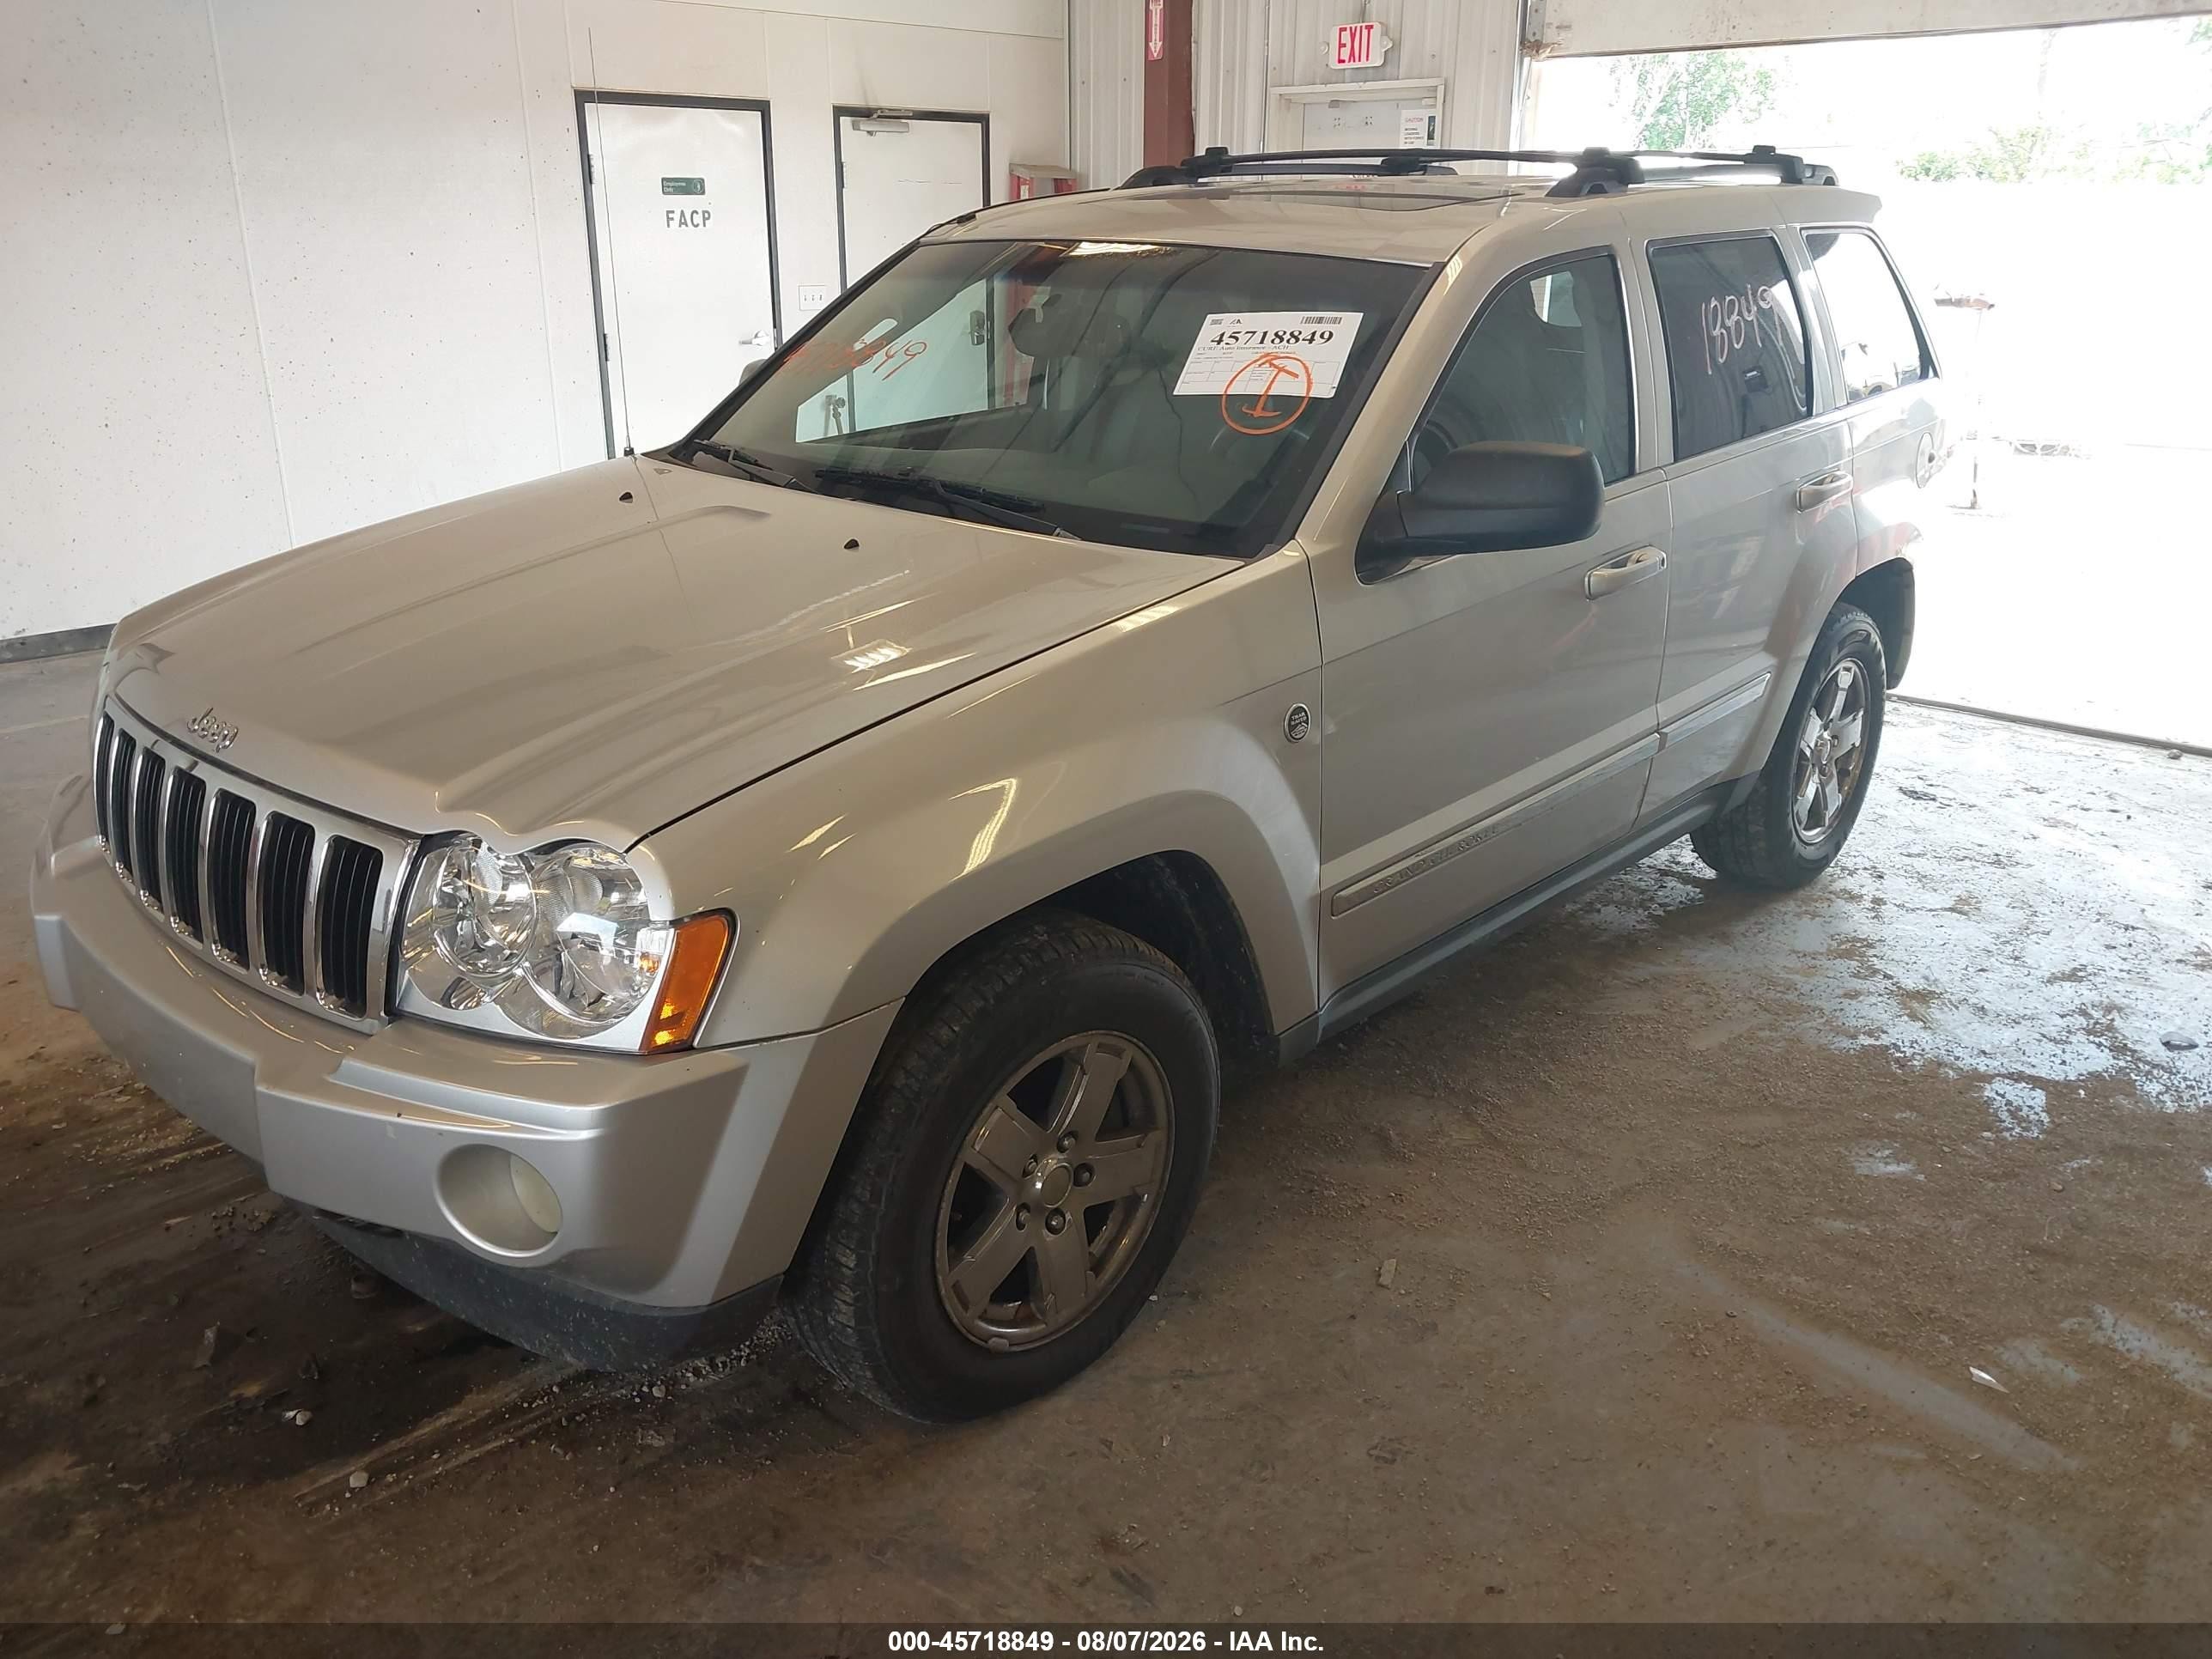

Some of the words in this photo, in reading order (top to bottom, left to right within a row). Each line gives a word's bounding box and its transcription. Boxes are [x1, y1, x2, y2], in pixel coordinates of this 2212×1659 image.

[1338, 24, 1374, 64] EXIT
[665, 210, 711, 228] FACP
[1210, 330, 1334, 345] 45718849
[1701, 283, 1783, 375] 18849
[187, 708, 239, 753] Jeep
